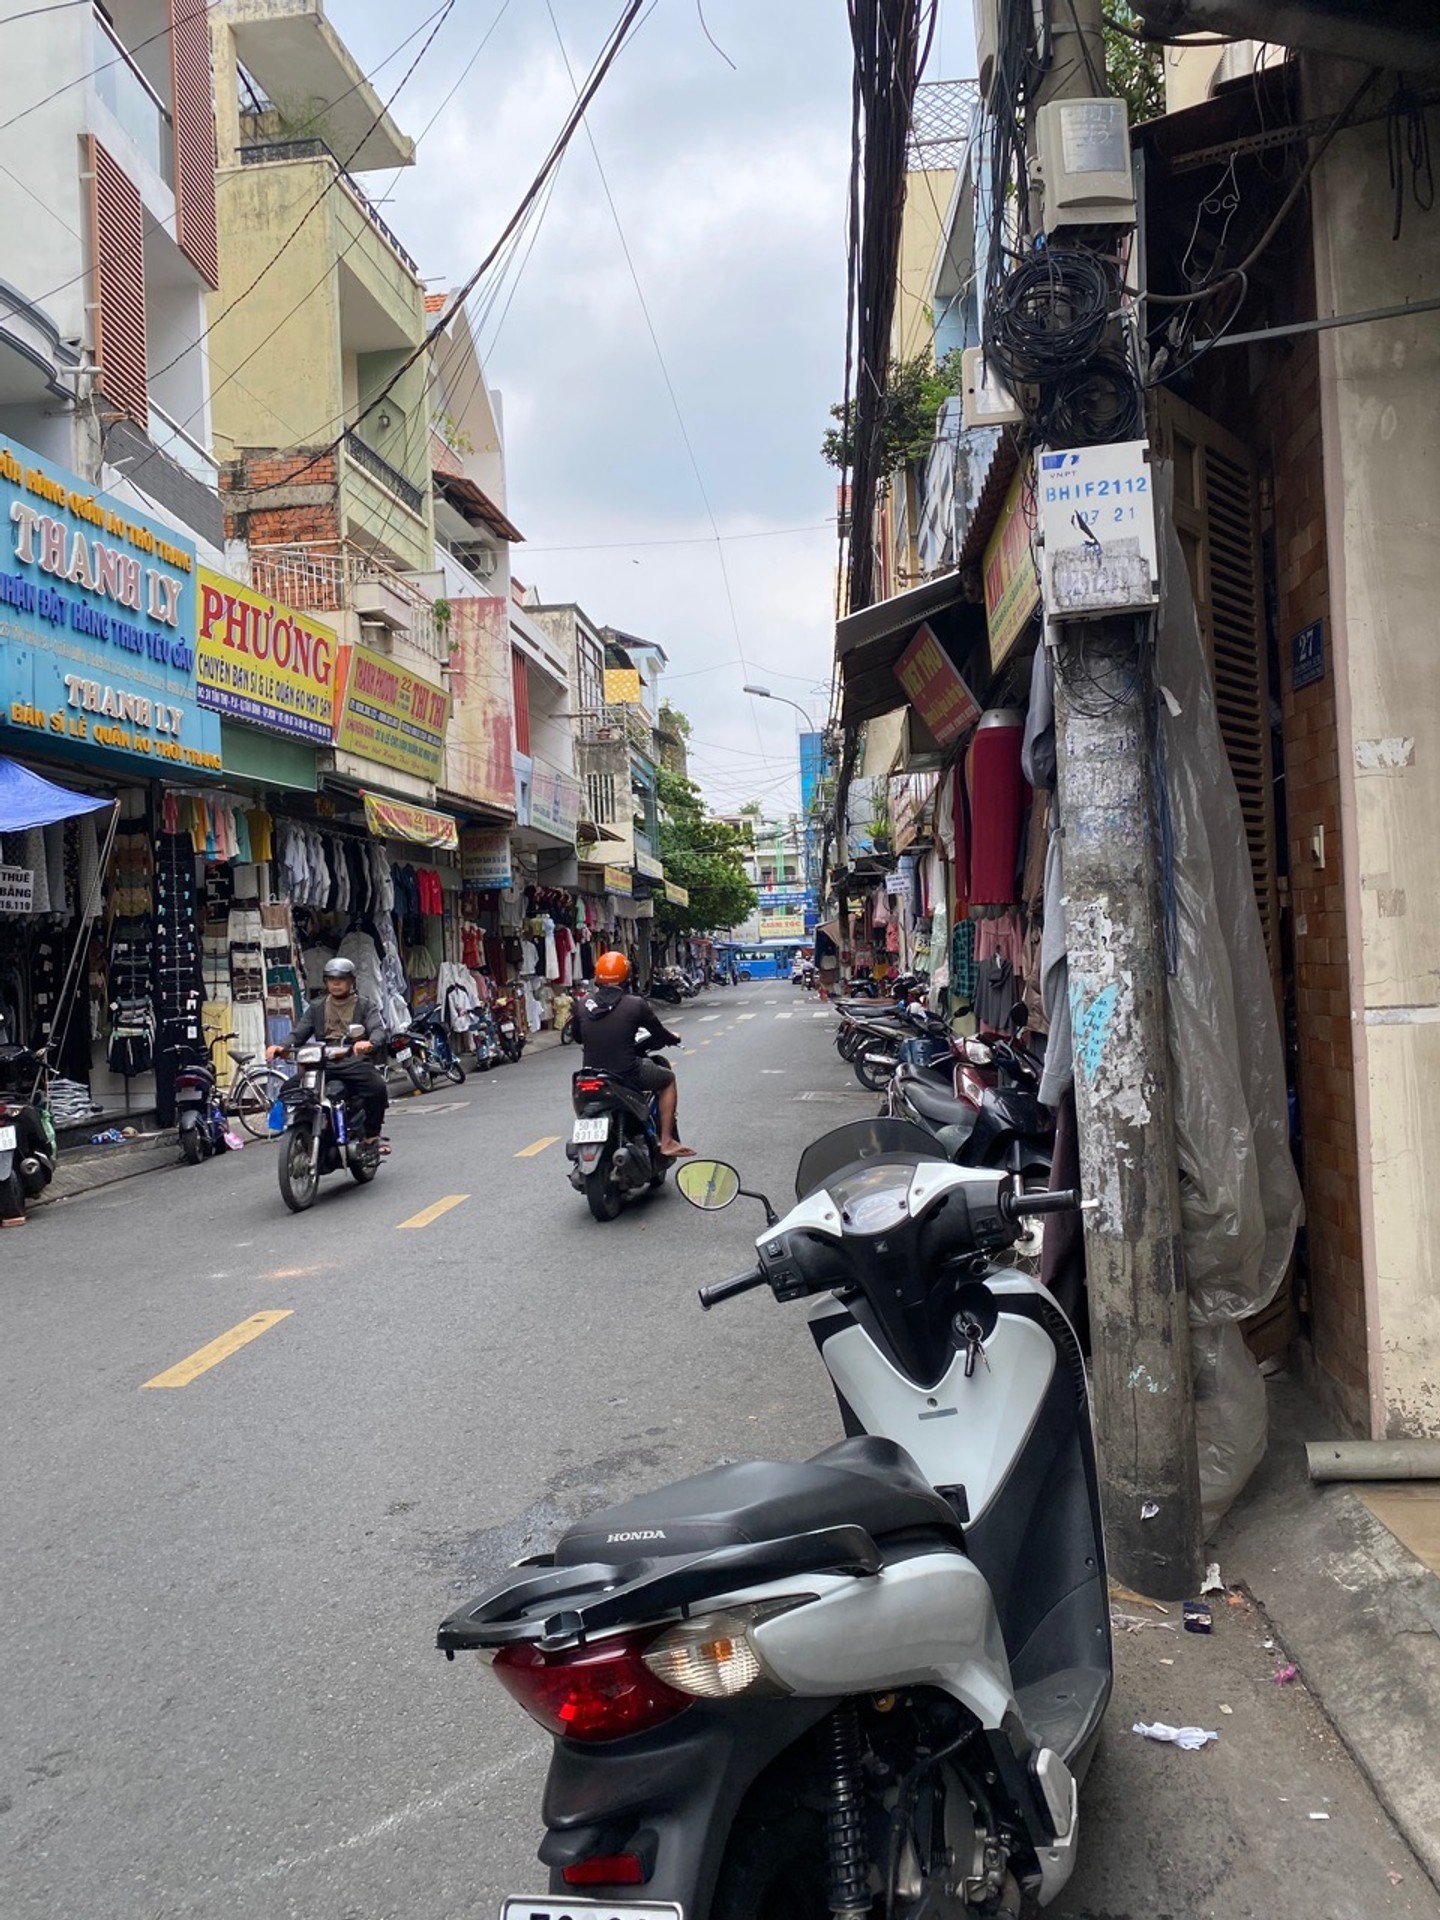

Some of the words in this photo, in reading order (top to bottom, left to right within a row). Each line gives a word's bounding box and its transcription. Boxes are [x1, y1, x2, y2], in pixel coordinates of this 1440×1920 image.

[10, 500, 141, 610] THANH
[147, 568, 182, 627] LY
[156, 540, 192, 573] TRANG
[72, 599, 109, 641] HÀNG
[112, 618, 144, 655] THEO
[200, 584, 331, 686] PHƯƠNG
[1299, 629, 1314, 661] 27
[65, 673, 151, 727] THANH
[155, 702, 184, 737] LY
[400, 676, 412, 693] 22
[11, 702, 45, 730] BÁN
[184, 749, 221, 770] TRANG
[2, 872, 30, 883] THUÊ
[606, 1530, 667, 1544] HONDA
